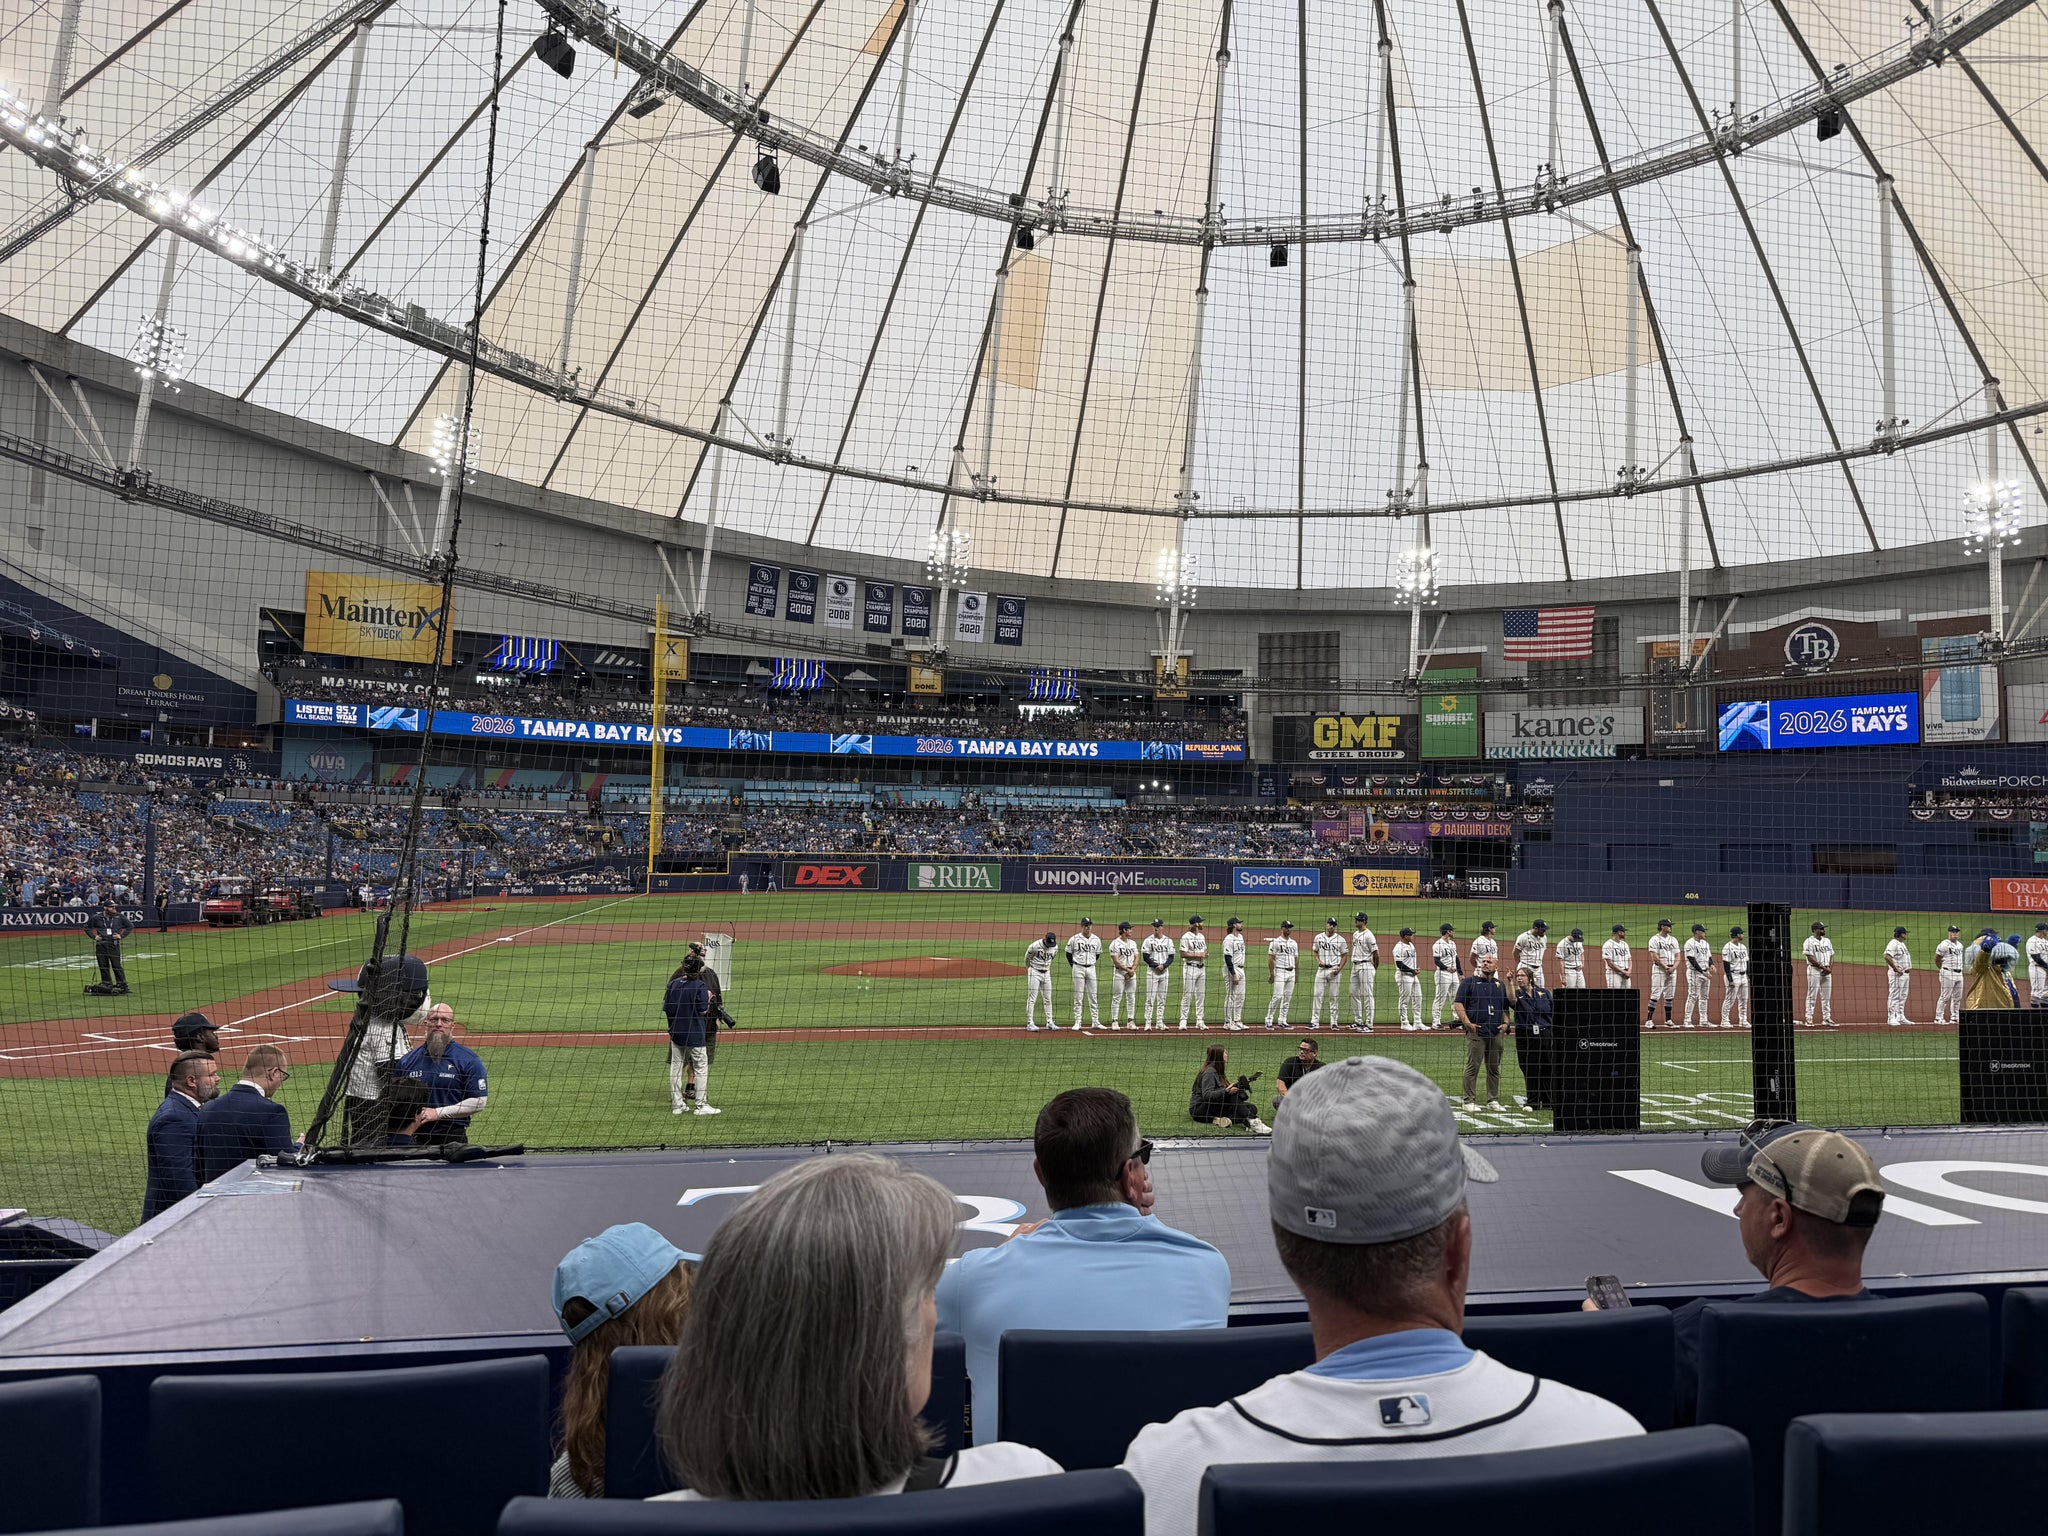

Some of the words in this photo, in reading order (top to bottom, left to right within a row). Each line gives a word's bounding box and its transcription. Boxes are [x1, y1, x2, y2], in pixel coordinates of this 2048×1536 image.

[789, 592, 815, 602] CHAMPIONS
[790, 603, 812, 615] 2008
[866, 604, 892, 612] CHAMPIONS
[904, 607, 929, 615] CHAMPIONS
[318, 593, 442, 640] MaintenX
[828, 609, 850, 620] 2008
[868, 614, 888, 625] 2010
[906, 618, 927, 628] 2020
[360, 626, 401, 640] SKYDECK
[960, 624, 980, 634] 2020
[1000, 628, 1018, 638] 2021
[1795, 633, 1831, 660] TB
[118, 687, 146, 697] DREAM
[148, 690, 177, 700] FINDERS
[178, 693, 205, 702] HOMES
[144, 698, 179, 708] TERRACE
[296, 704, 333, 715] LISTEN
[336, 705, 357, 715] 95.7
[1851, 706, 1886, 716] TAMPA
[1888, 705, 1908, 714] BAY
[1512, 712, 1615, 738] kane's
[1779, 710, 1848, 735] 2026
[1852, 714, 1908, 732] RAYS
[472, 716, 516, 734] 2026
[520, 719, 590, 738] TAMPA
[594, 724, 632, 741] BAY
[636, 726, 682, 743] RAYS
[1314, 717, 1401, 748] GMF
[916, 739, 954, 753] 2026
[958, 740, 1018, 755] TAMPA
[1021, 742, 1054, 756] BAY
[1056, 742, 1099, 756] RAYS
[1185, 744, 1220, 752] REPUBLIC
[1220, 744, 1242, 752] BANK
[136, 754, 186, 767] SOMOS
[188, 756, 222, 768] RAYS
[234, 758, 247, 770] TB
[310, 754, 345, 770] VIVA
[1941, 777, 1998, 786] Budweiser
[1326, 788, 1336, 796] WE
[1343, 788, 1355, 796] THE
[1373, 788, 1383, 796] WE
[1396, 788, 1406, 796] ST.
[1407, 788, 1422, 796] PETE
[1445, 824, 1484, 836] DAIQUIRI
[1484, 824, 1512, 837] DECK
[794, 865, 868, 886] DEX
[938, 866, 993, 888] RIPA
[1240, 872, 1306, 889] Spectrum
[658, 879, 669, 887] 315
[1144, 878, 1198, 886] MORTGAGE
[1370, 882, 1414, 890] CLEARWATER
[1684, 892, 1700, 900] 404
[1, 912, 89, 926] RAYMOND
